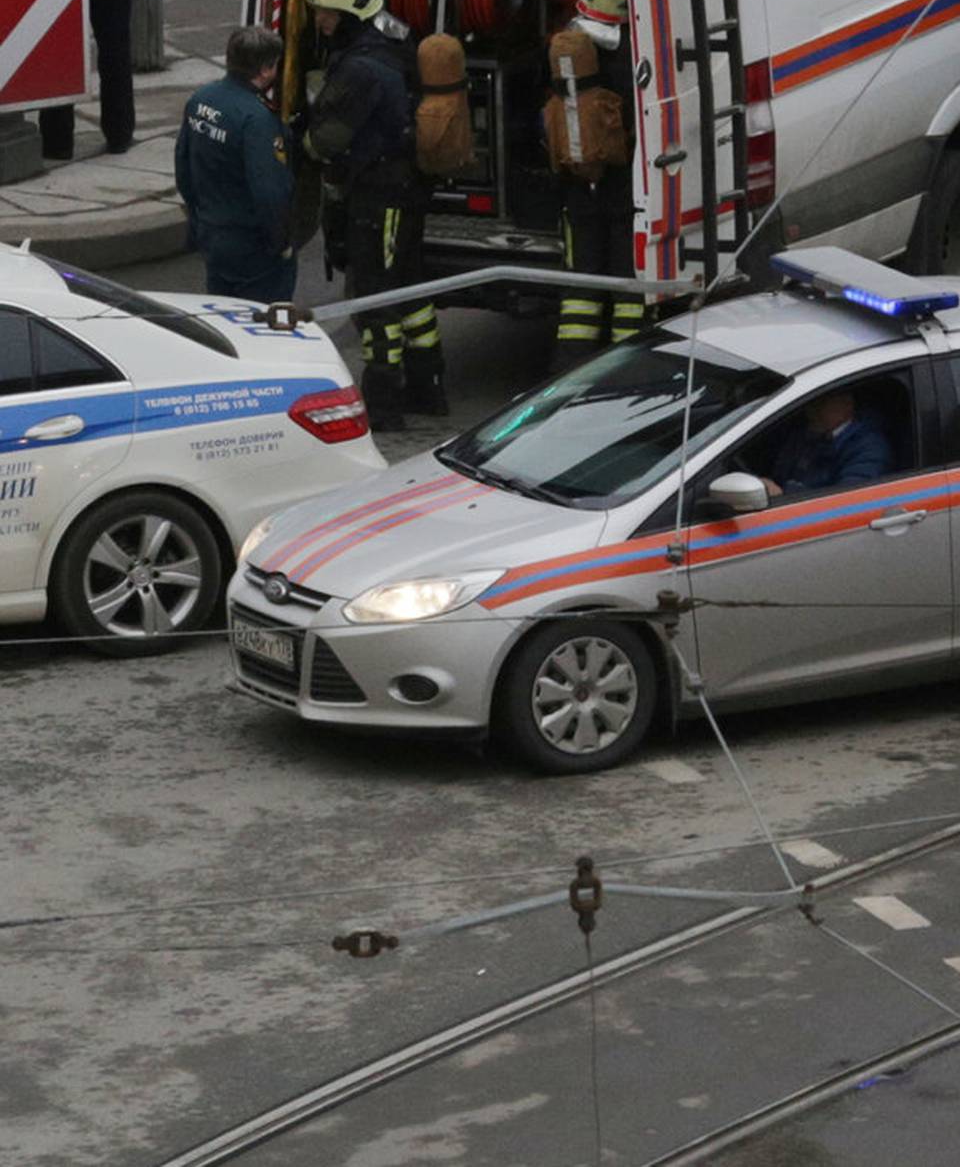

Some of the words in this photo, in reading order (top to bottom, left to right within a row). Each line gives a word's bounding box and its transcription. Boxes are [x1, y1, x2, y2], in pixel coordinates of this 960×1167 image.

[144, 395, 193, 409] ТЕЛЕФОН
[251, 386, 284, 398] ЧАСТИ
[190, 437, 237, 451] ТЕЛЕФОН
[238, 431, 285, 446] ДОВЕРИЯ
